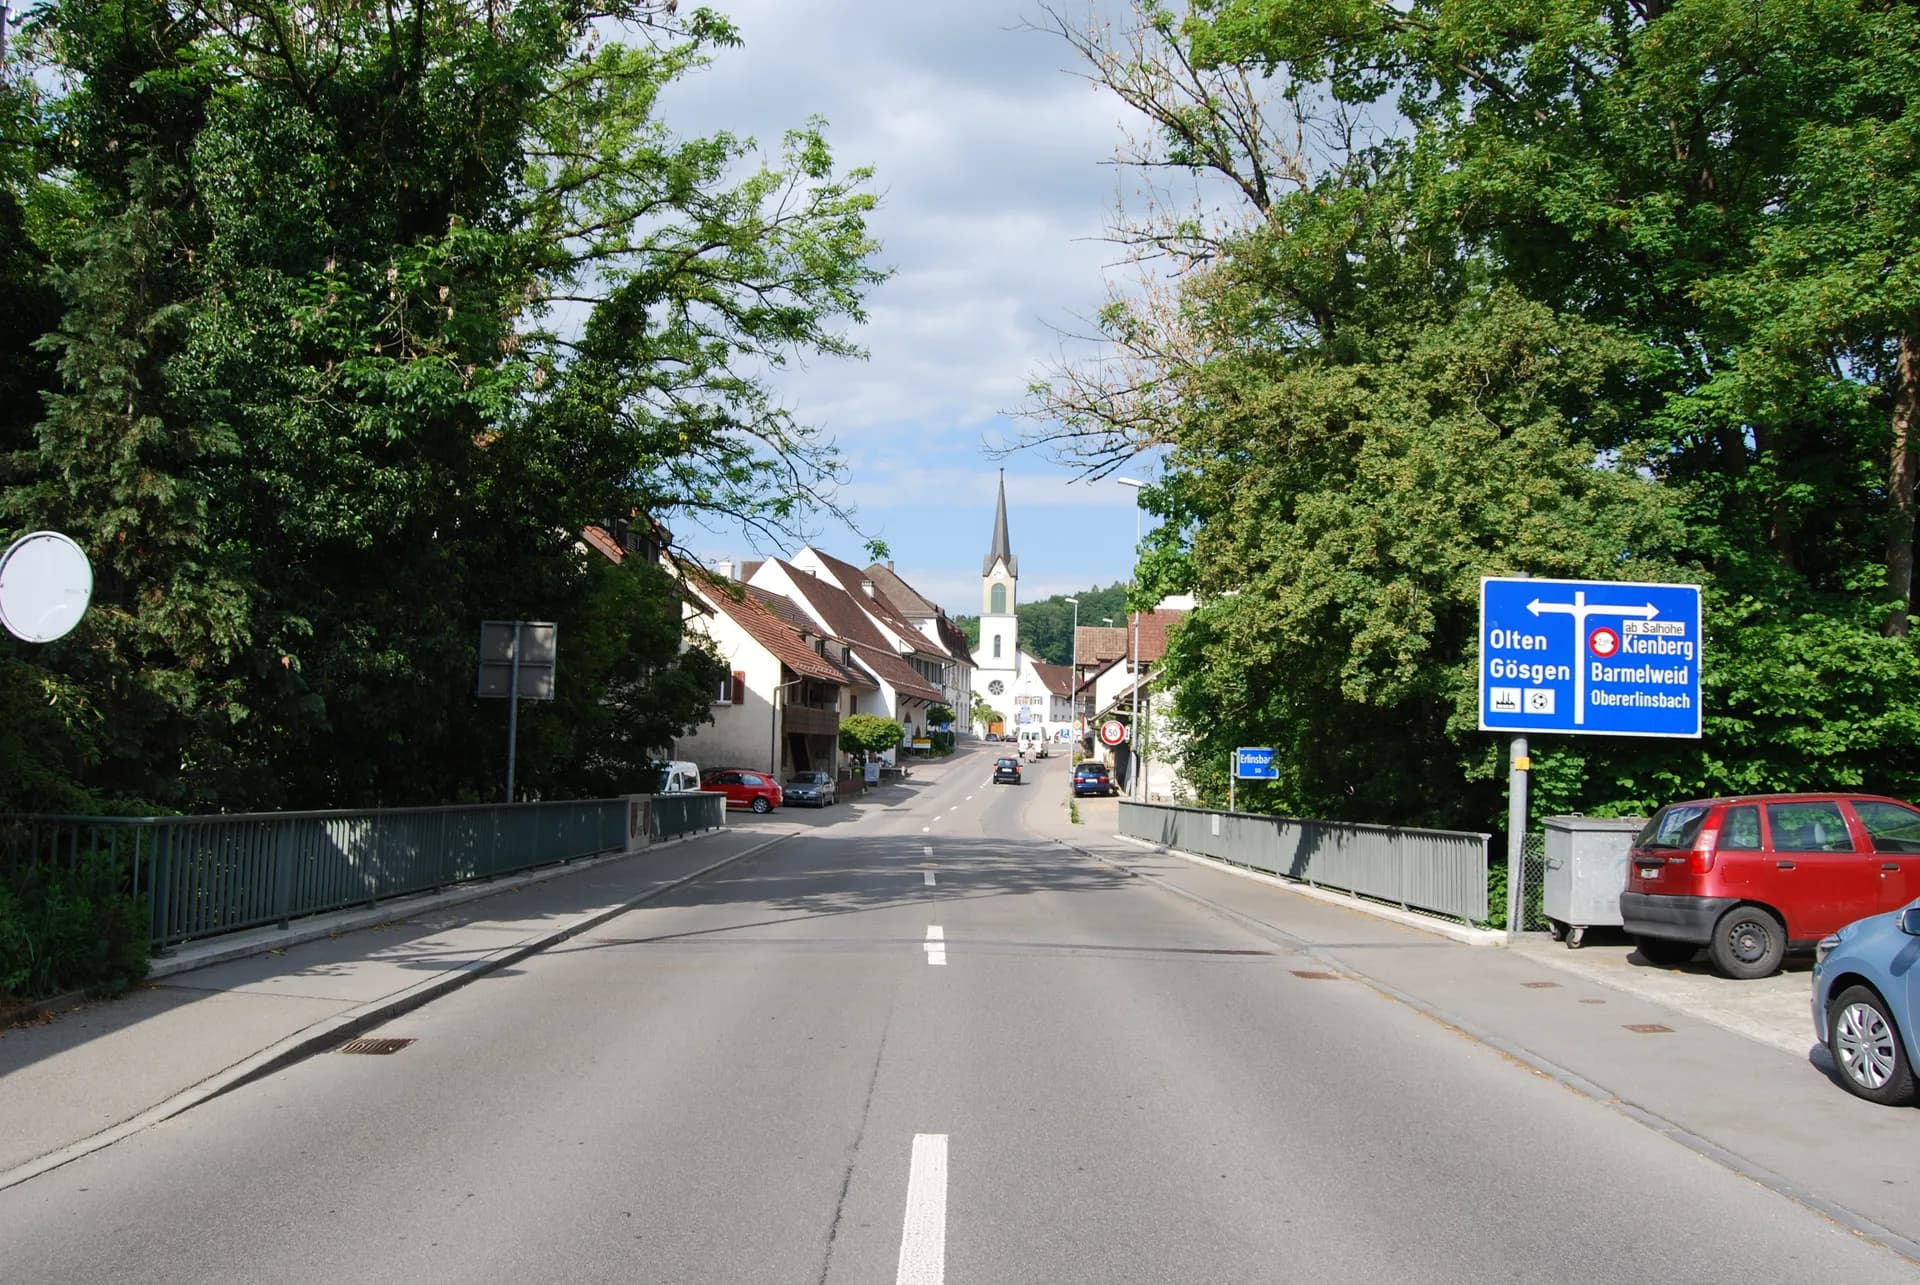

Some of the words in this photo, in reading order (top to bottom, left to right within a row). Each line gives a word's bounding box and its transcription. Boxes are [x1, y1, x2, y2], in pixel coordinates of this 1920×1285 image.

[1490, 628, 1547, 650] Olten
[1625, 622, 1637, 632] ab
[1642, 622, 1683, 634] Salhöhe
[1622, 634, 1693, 660] Kienberg
[1490, 658, 1570, 684] Gösgen
[1591, 662, 1688, 685] Barmelweid
[1591, 689, 1690, 709] Obererlinsbach
[1108, 728, 1118, 738] 50
